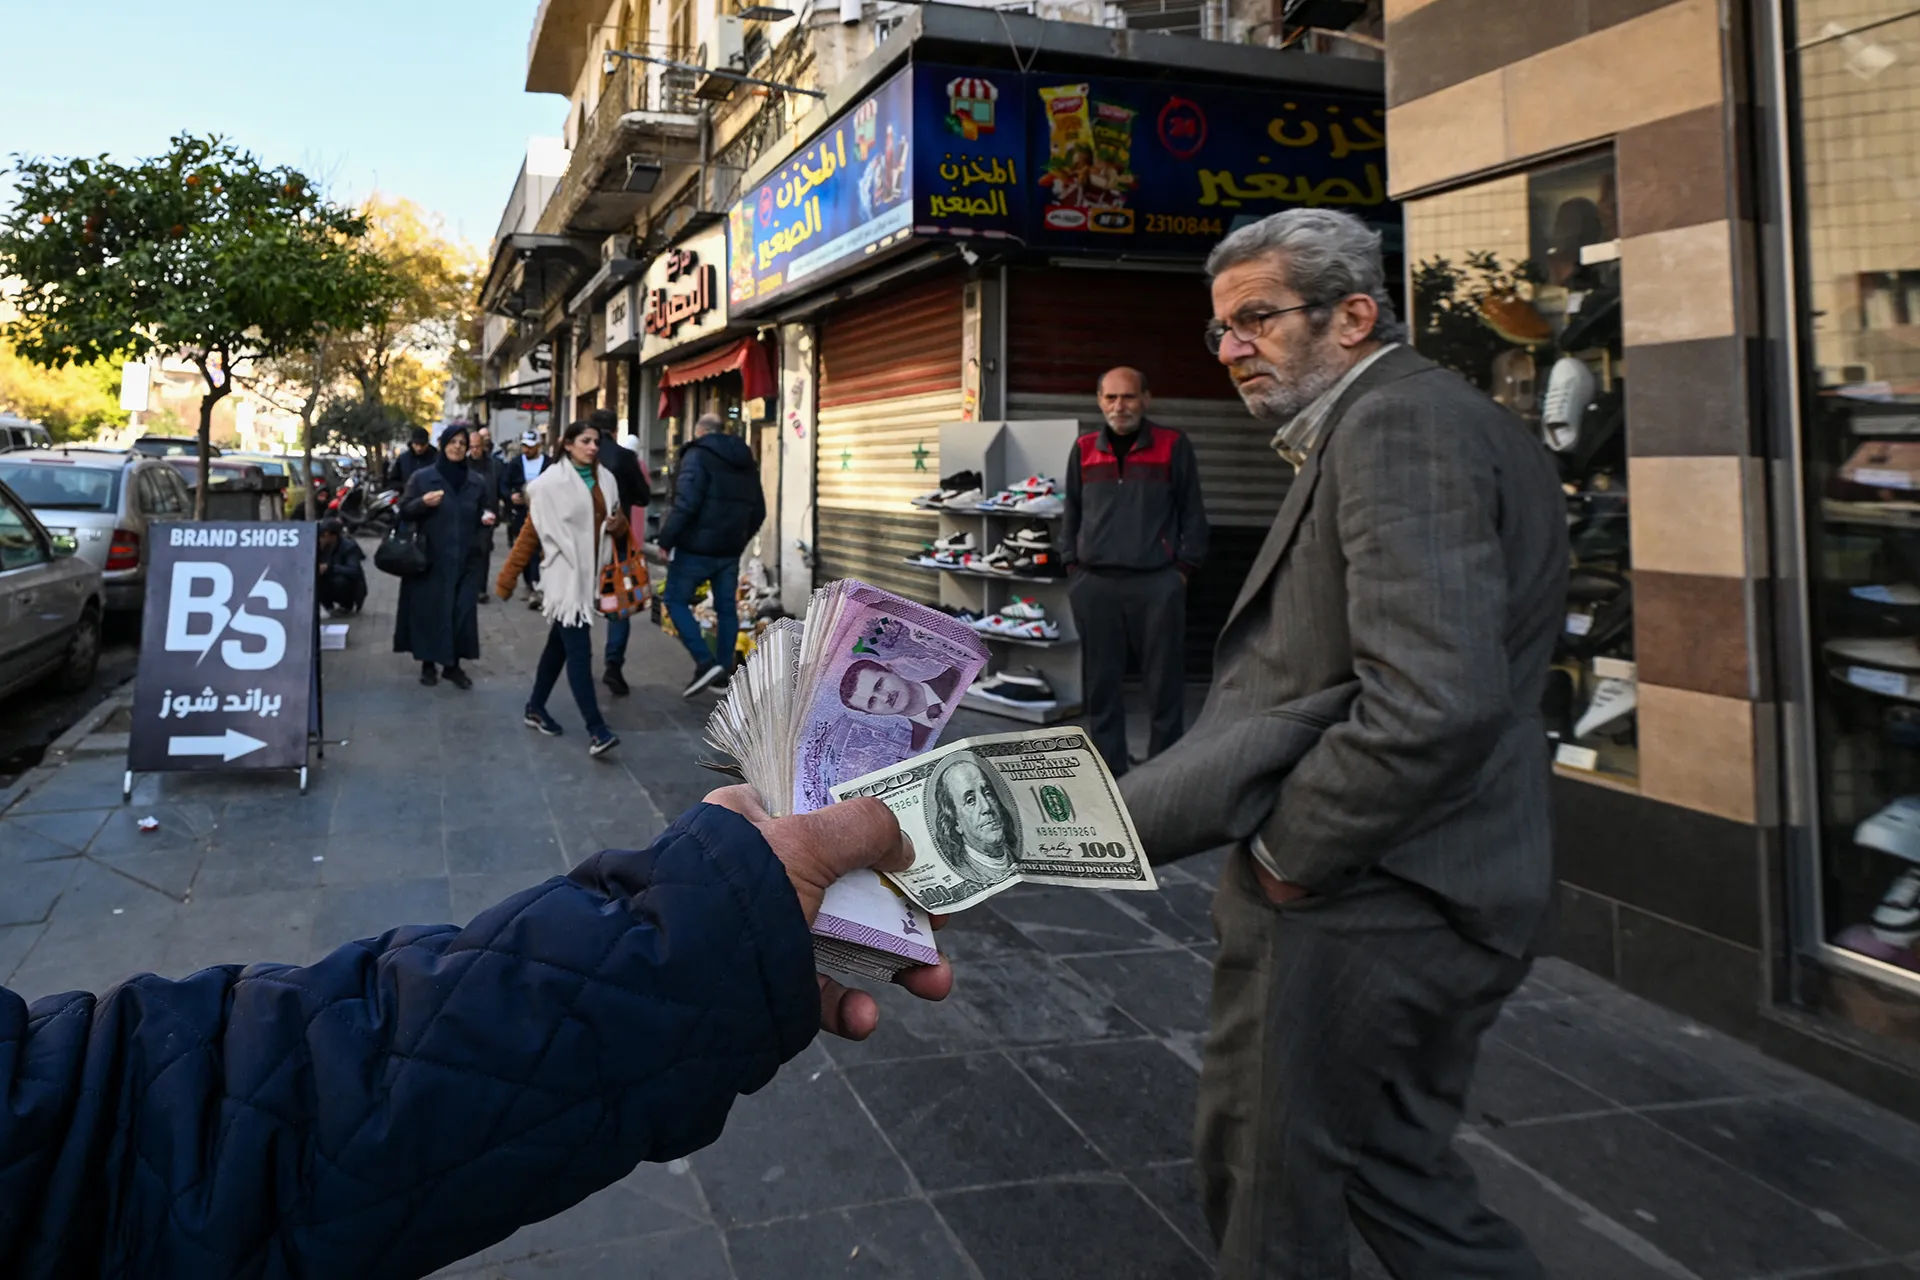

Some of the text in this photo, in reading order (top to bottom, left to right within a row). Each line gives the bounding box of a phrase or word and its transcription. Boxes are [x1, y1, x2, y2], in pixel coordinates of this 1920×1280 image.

[1169, 117, 1196, 138] 24
[776, 129, 847, 209] المخزن
[939, 153, 1017, 187] المخزن
[929, 186, 1008, 218] الصغير
[758, 195, 822, 271] الصغير
[1144, 213, 1223, 235] 2310844
[170, 527, 300, 547] BRAND SHOES
[158, 685, 282, 719] براند شوز
[1009, 766, 1077, 781] OF AMERICA
[1034, 756, 1081, 770] STATES
[1078, 842, 1126, 859] 100
[1040, 864, 1087, 873] HUNDRED
[1085, 865, 1137, 874] DOLLARS
[919, 884, 954, 908] 100
